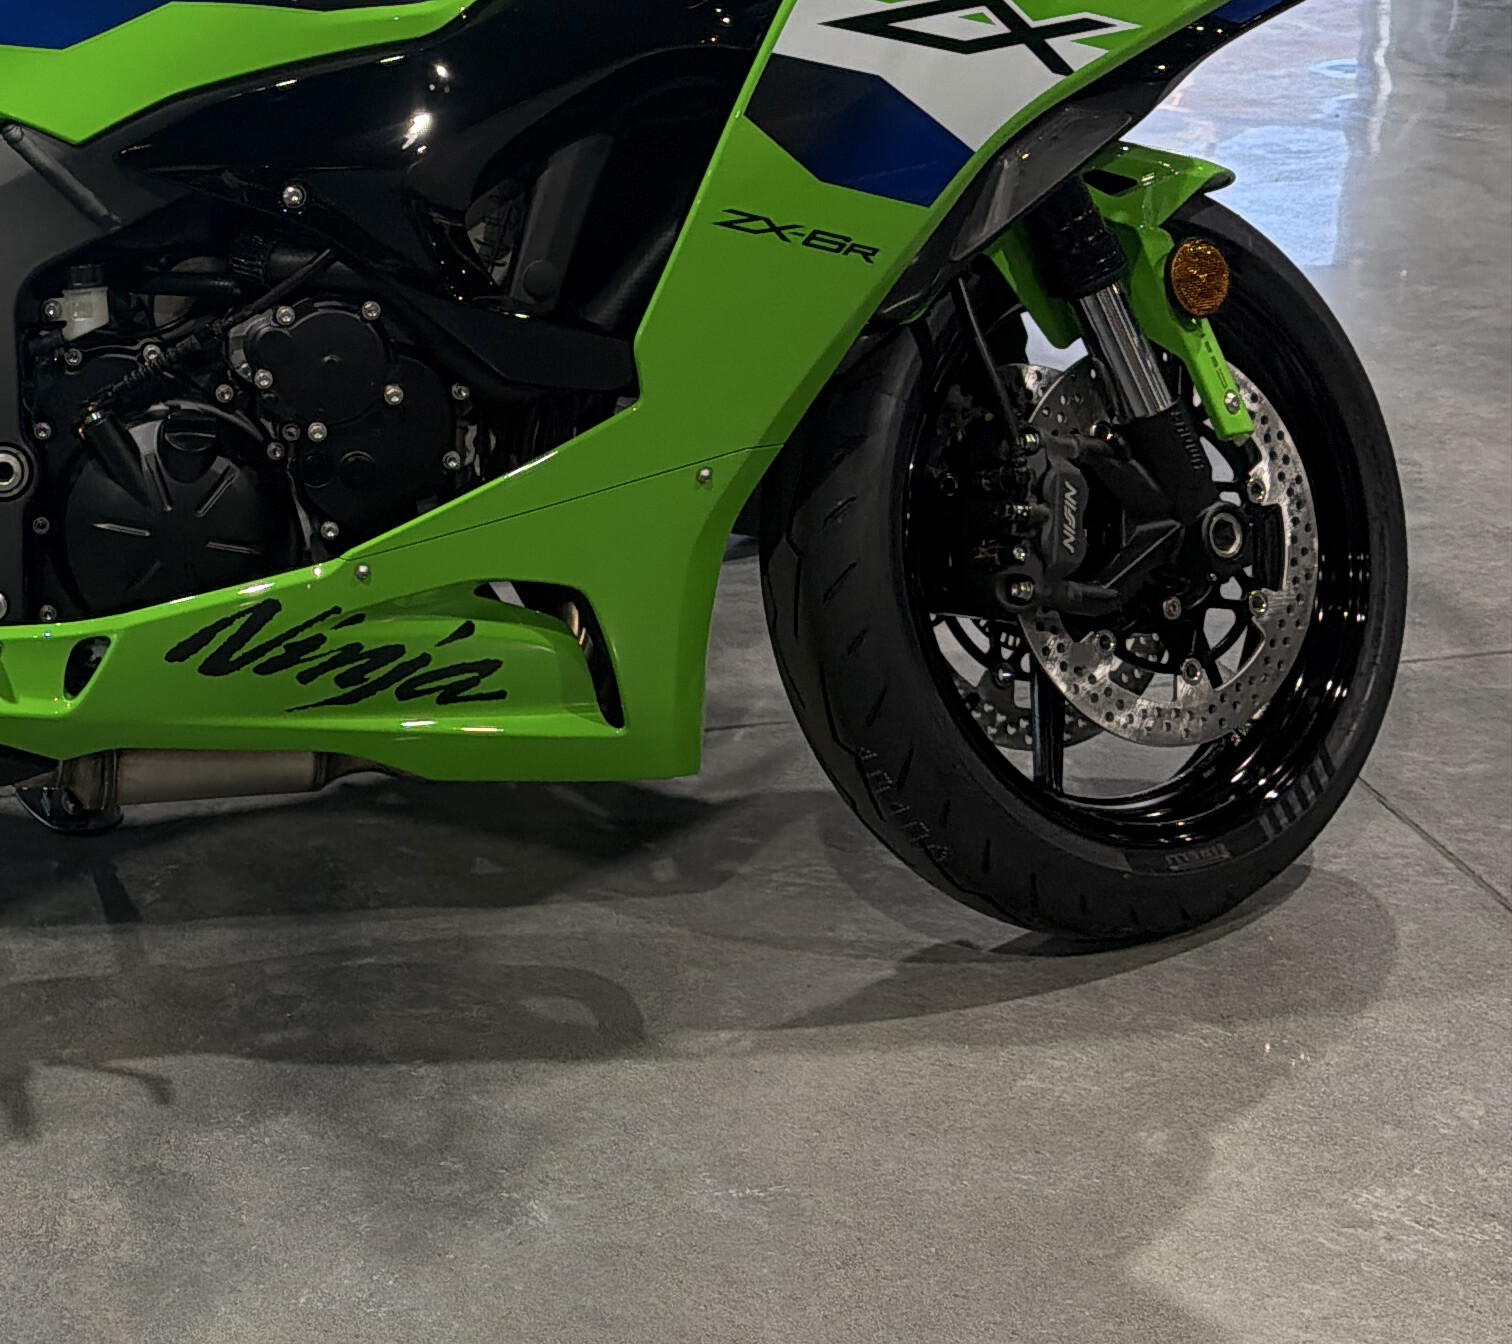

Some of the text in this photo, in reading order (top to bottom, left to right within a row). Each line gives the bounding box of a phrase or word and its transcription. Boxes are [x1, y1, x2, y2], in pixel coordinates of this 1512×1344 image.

[712, 208, 881, 265] ZX-6R
[1062, 480, 1079, 555] NISSIN
[164, 597, 508, 713] Ninja
